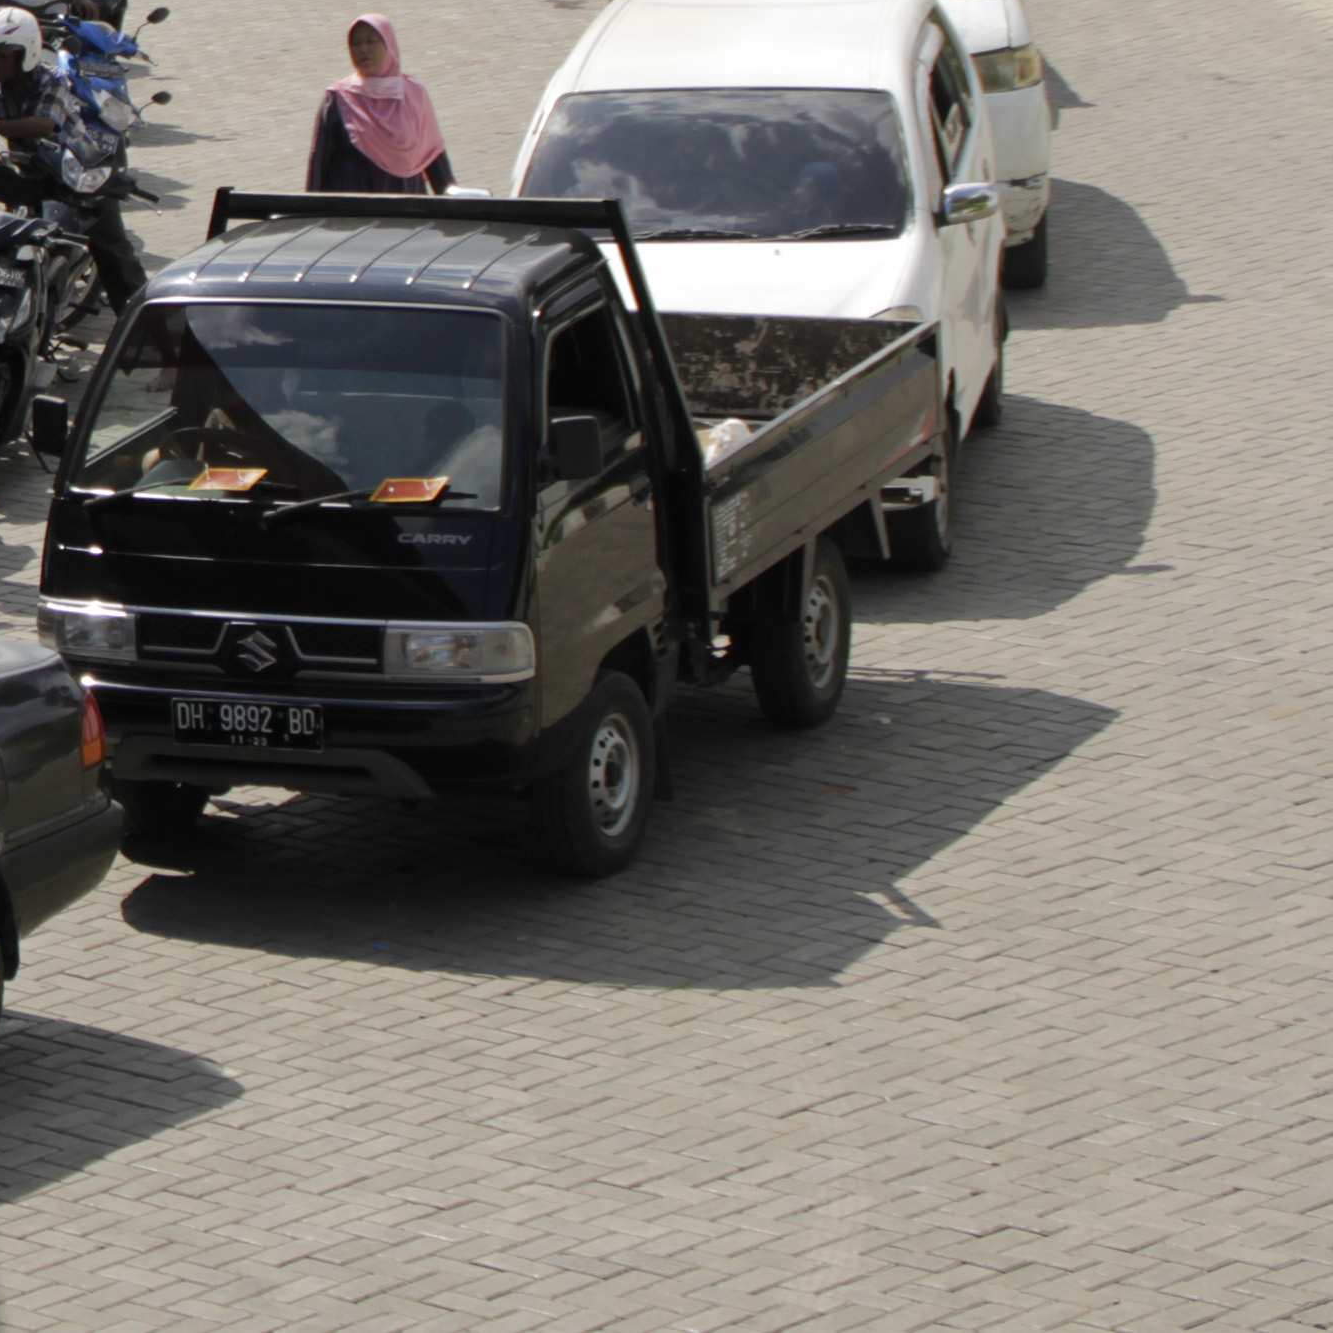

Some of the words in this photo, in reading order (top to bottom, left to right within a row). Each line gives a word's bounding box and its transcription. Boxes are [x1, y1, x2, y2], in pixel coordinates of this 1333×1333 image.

[396, 532, 473, 546] CARRY
[176, 702, 205, 730] DH
[219, 703, 274, 734] 9892
[288, 707, 316, 736] BD
